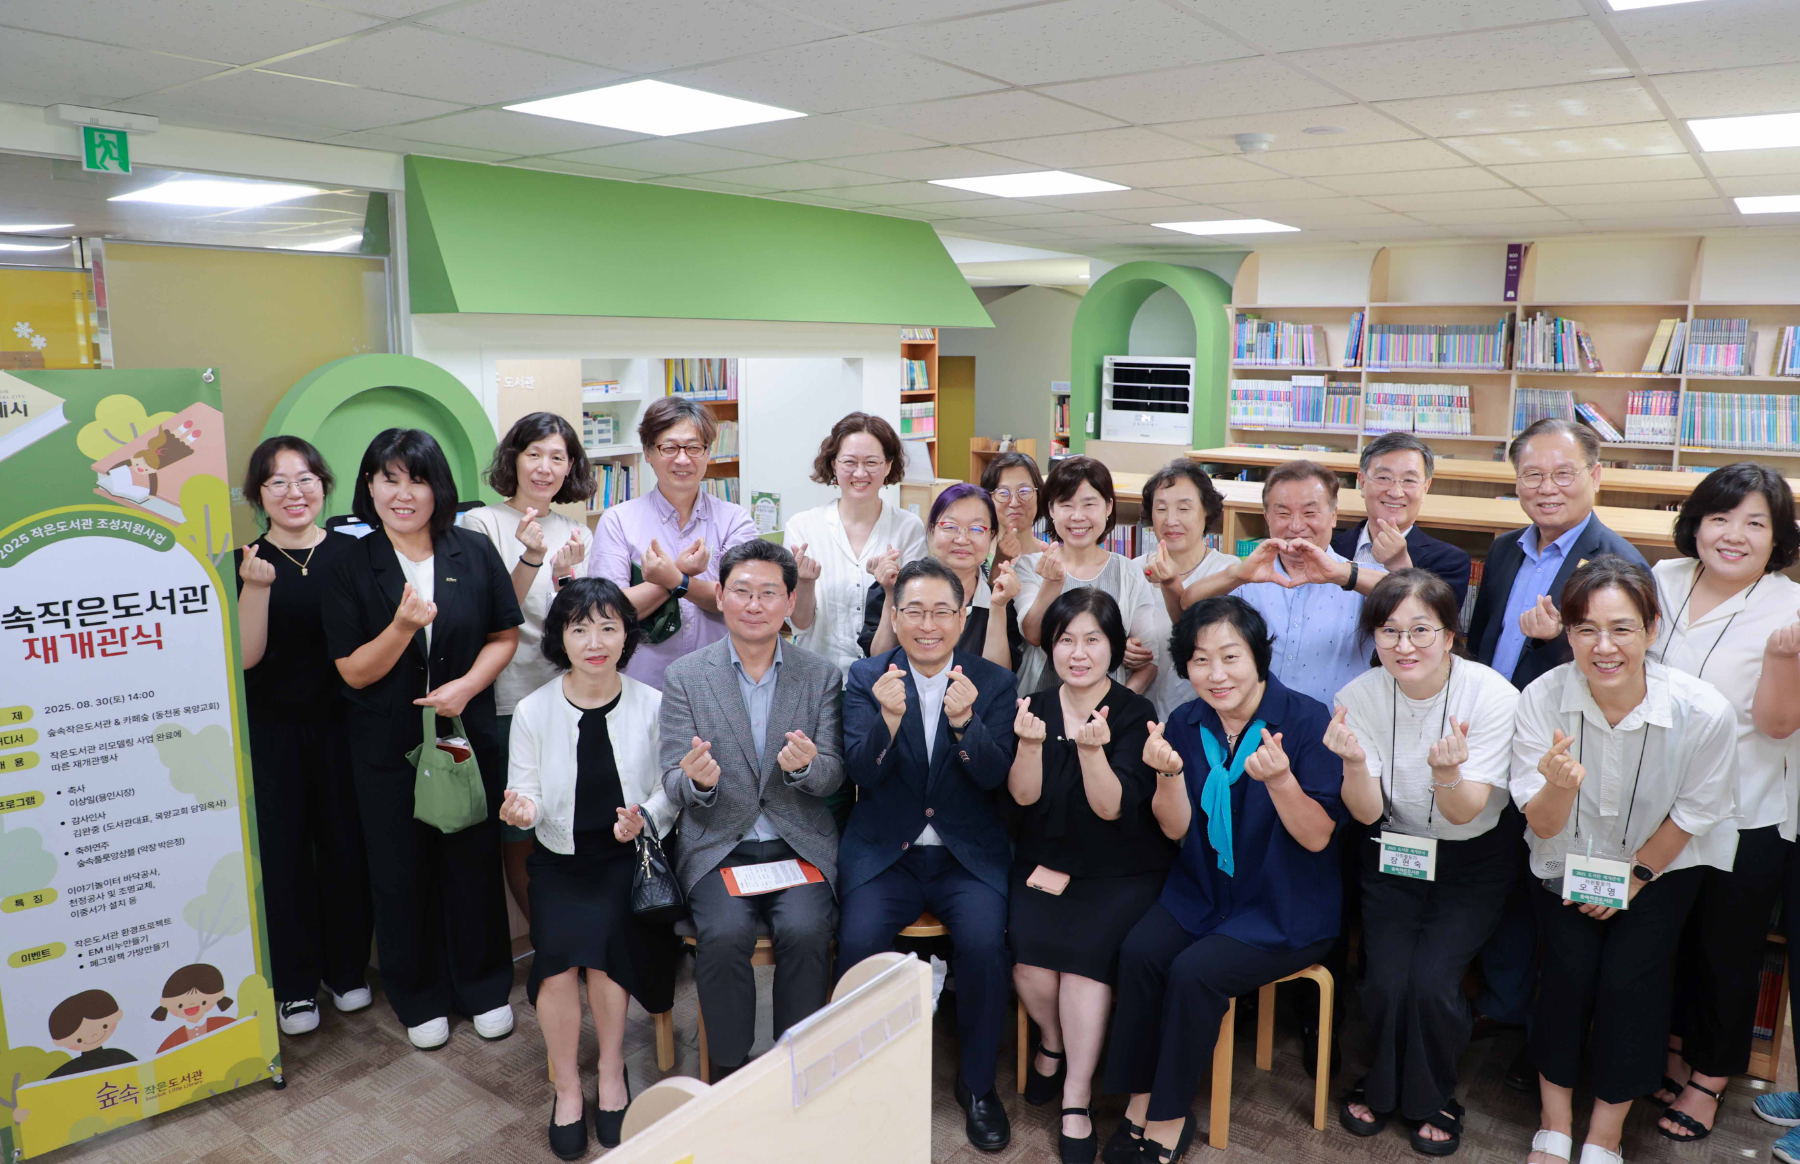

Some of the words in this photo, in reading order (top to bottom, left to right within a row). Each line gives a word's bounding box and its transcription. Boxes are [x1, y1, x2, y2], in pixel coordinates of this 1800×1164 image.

[504, 376, 534, 389] 도서관
[0, 533, 30, 560] 2025
[30, 518, 93, 538] 작은도서관
[96, 518, 167, 546] 조성지원사업
[1, 584, 210, 634] 속작은도서관
[22, 622, 163, 664] 재개관식
[45, 703, 74, 714] 2025.
[77, 701, 92, 709] 08.
[96, 696, 125, 706] 30(토)
[128, 690, 154, 701] 14:00
[12, 711, 23, 720] 제
[48, 719, 111, 737] 숲속작은도서관
[123, 714, 149, 724] 카페숲
[152, 708, 180, 720] (동천동
[184, 702, 220, 714] 목양교회)
[50, 745, 96, 759] 작은도서관
[99, 738, 134, 751] 리모델링
[137, 735, 154, 745] 사업
[156, 730, 182, 741] 완료에
[51, 761, 70, 772] 따른
[73, 754, 118, 768] 재개관행사
[68, 784, 85, 794] 축사
[69, 788, 135, 806] 이상일(용인시장)
[72, 811, 106, 825] 감사인사
[103, 815, 152, 832] (도서관대표,
[155, 807, 188, 820] 목양교회
[191, 799, 226, 813] 담임목사)
[76, 841, 109, 854] 축하연주
[138, 843, 156, 855] (악장
[68, 877, 121, 894] 이야기놀이터
[123, 868, 160, 882] 바닥공사,
[69, 892, 105, 907] 천정공사
[107, 890, 116, 898] 및
[119, 881, 155, 896] 조명교체,
[71, 904, 106, 918] 이중서가
[109, 899, 126, 910] 설치
[74, 931, 119, 948] 작은도서관
[121, 917, 172, 937] 환경프로젝트
[21, 948, 51, 962] 이벤트
[88, 947, 104, 956] EM
[106, 934, 149, 951] 비누만들기
[127, 941, 170, 958] 가방만들기
[96, 1082, 140, 1110] 숲속
[144, 1069, 203, 1095] 작은도서관
